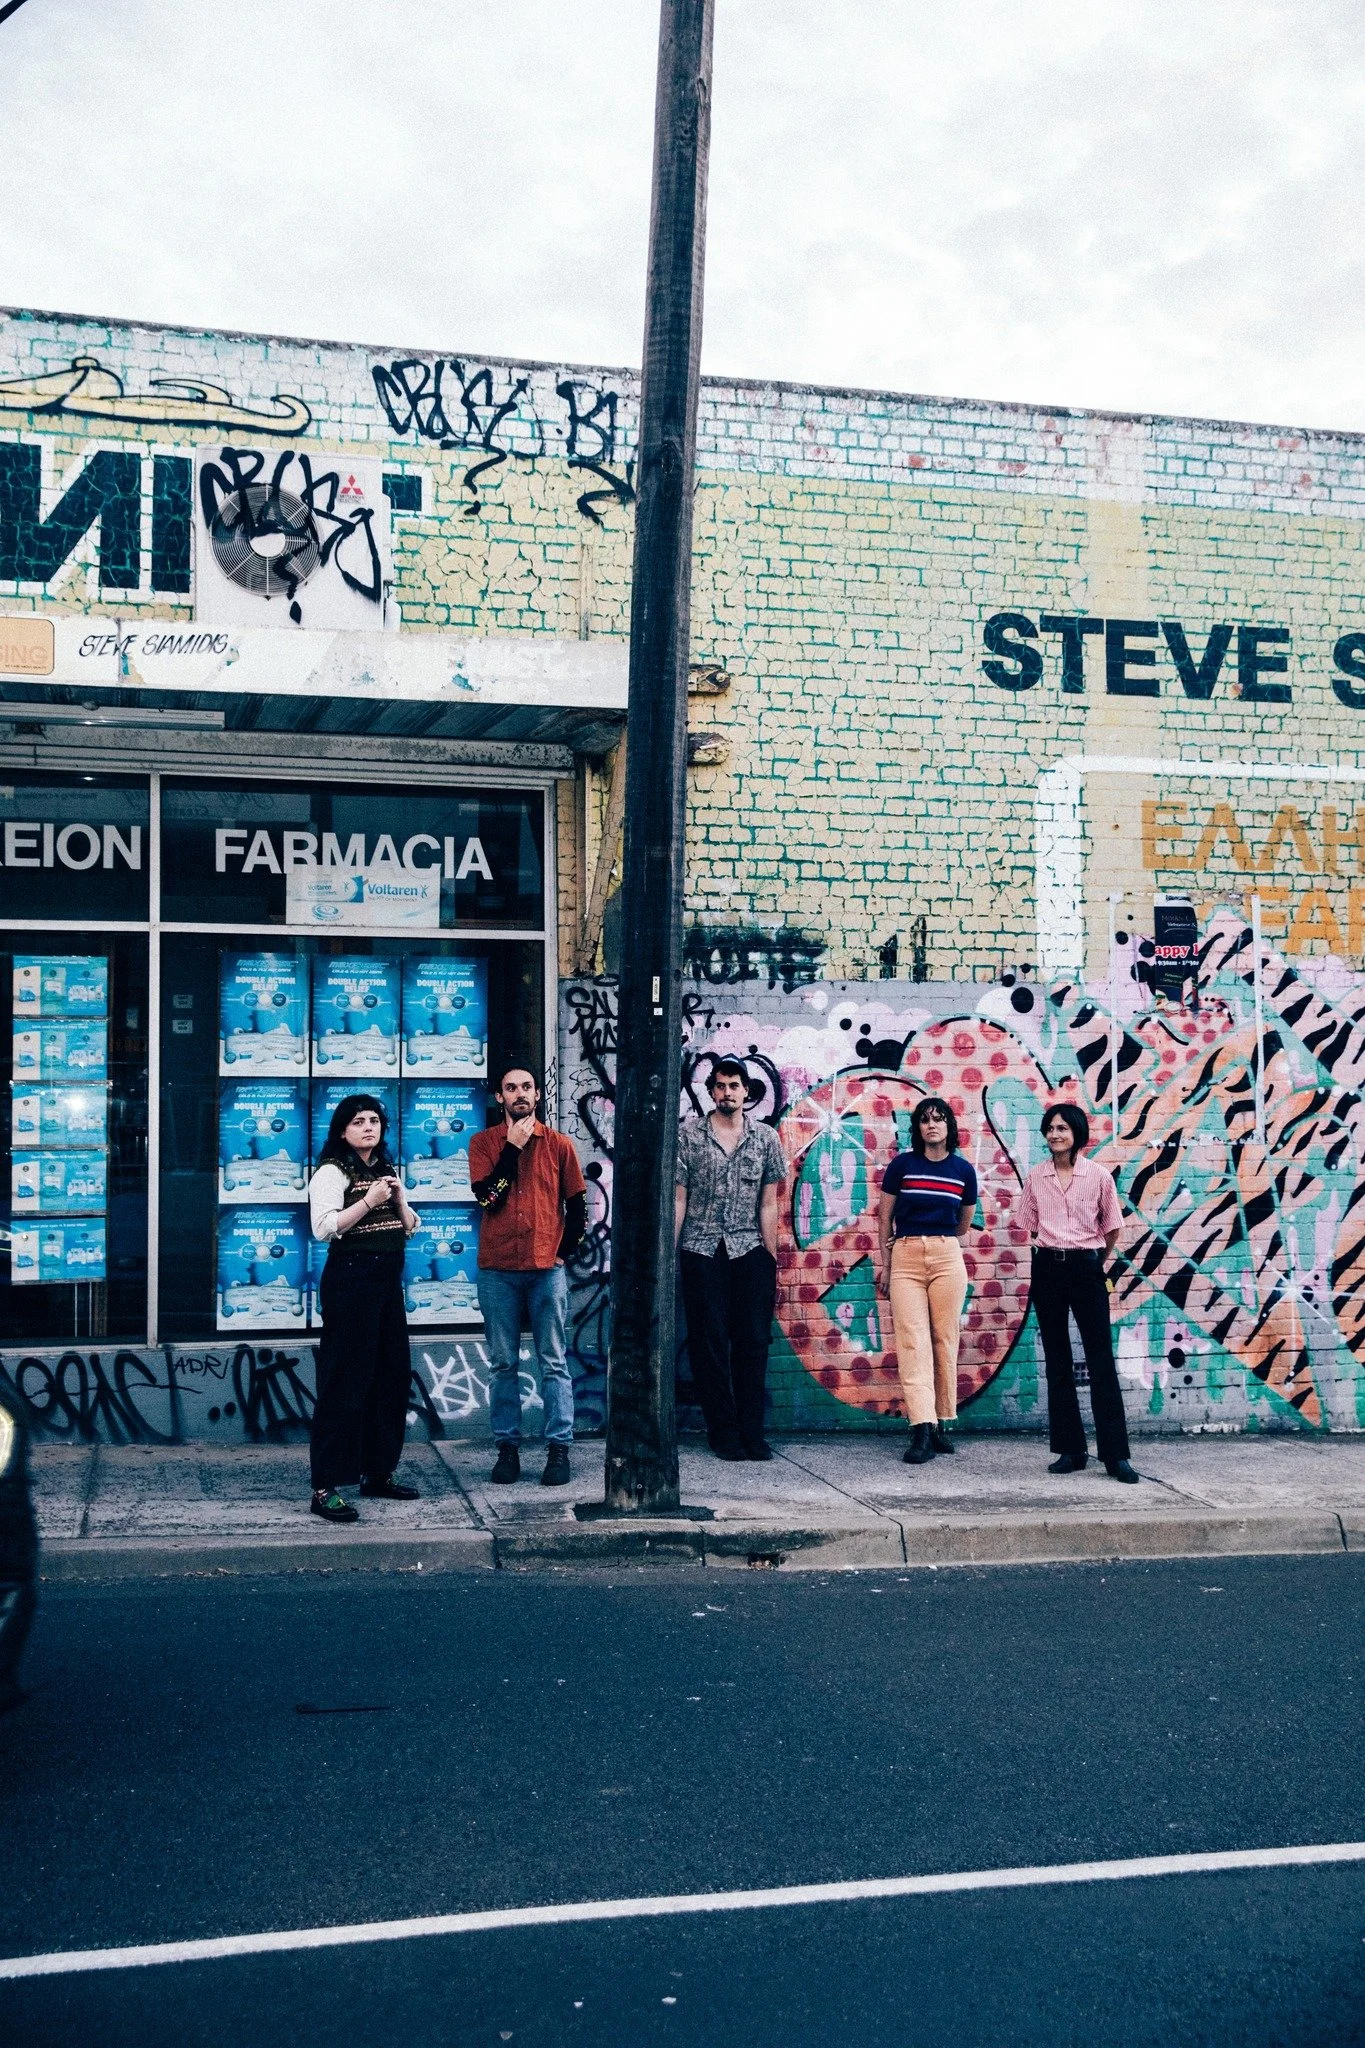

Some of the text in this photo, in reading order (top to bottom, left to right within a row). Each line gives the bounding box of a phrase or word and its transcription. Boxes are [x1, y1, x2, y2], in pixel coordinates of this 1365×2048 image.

[0, 644, 48, 664] ING
[78, 633, 229, 656] STEVE SIAMIDIS
[981, 611, 1292, 703] STEVE
[215, 828, 494, 880] FARMACIA
[368, 883, 417, 896] Voltaren
[236, 976, 296, 985] DOUBLE ACTION
[328, 978, 357, 986] DOUBLE
